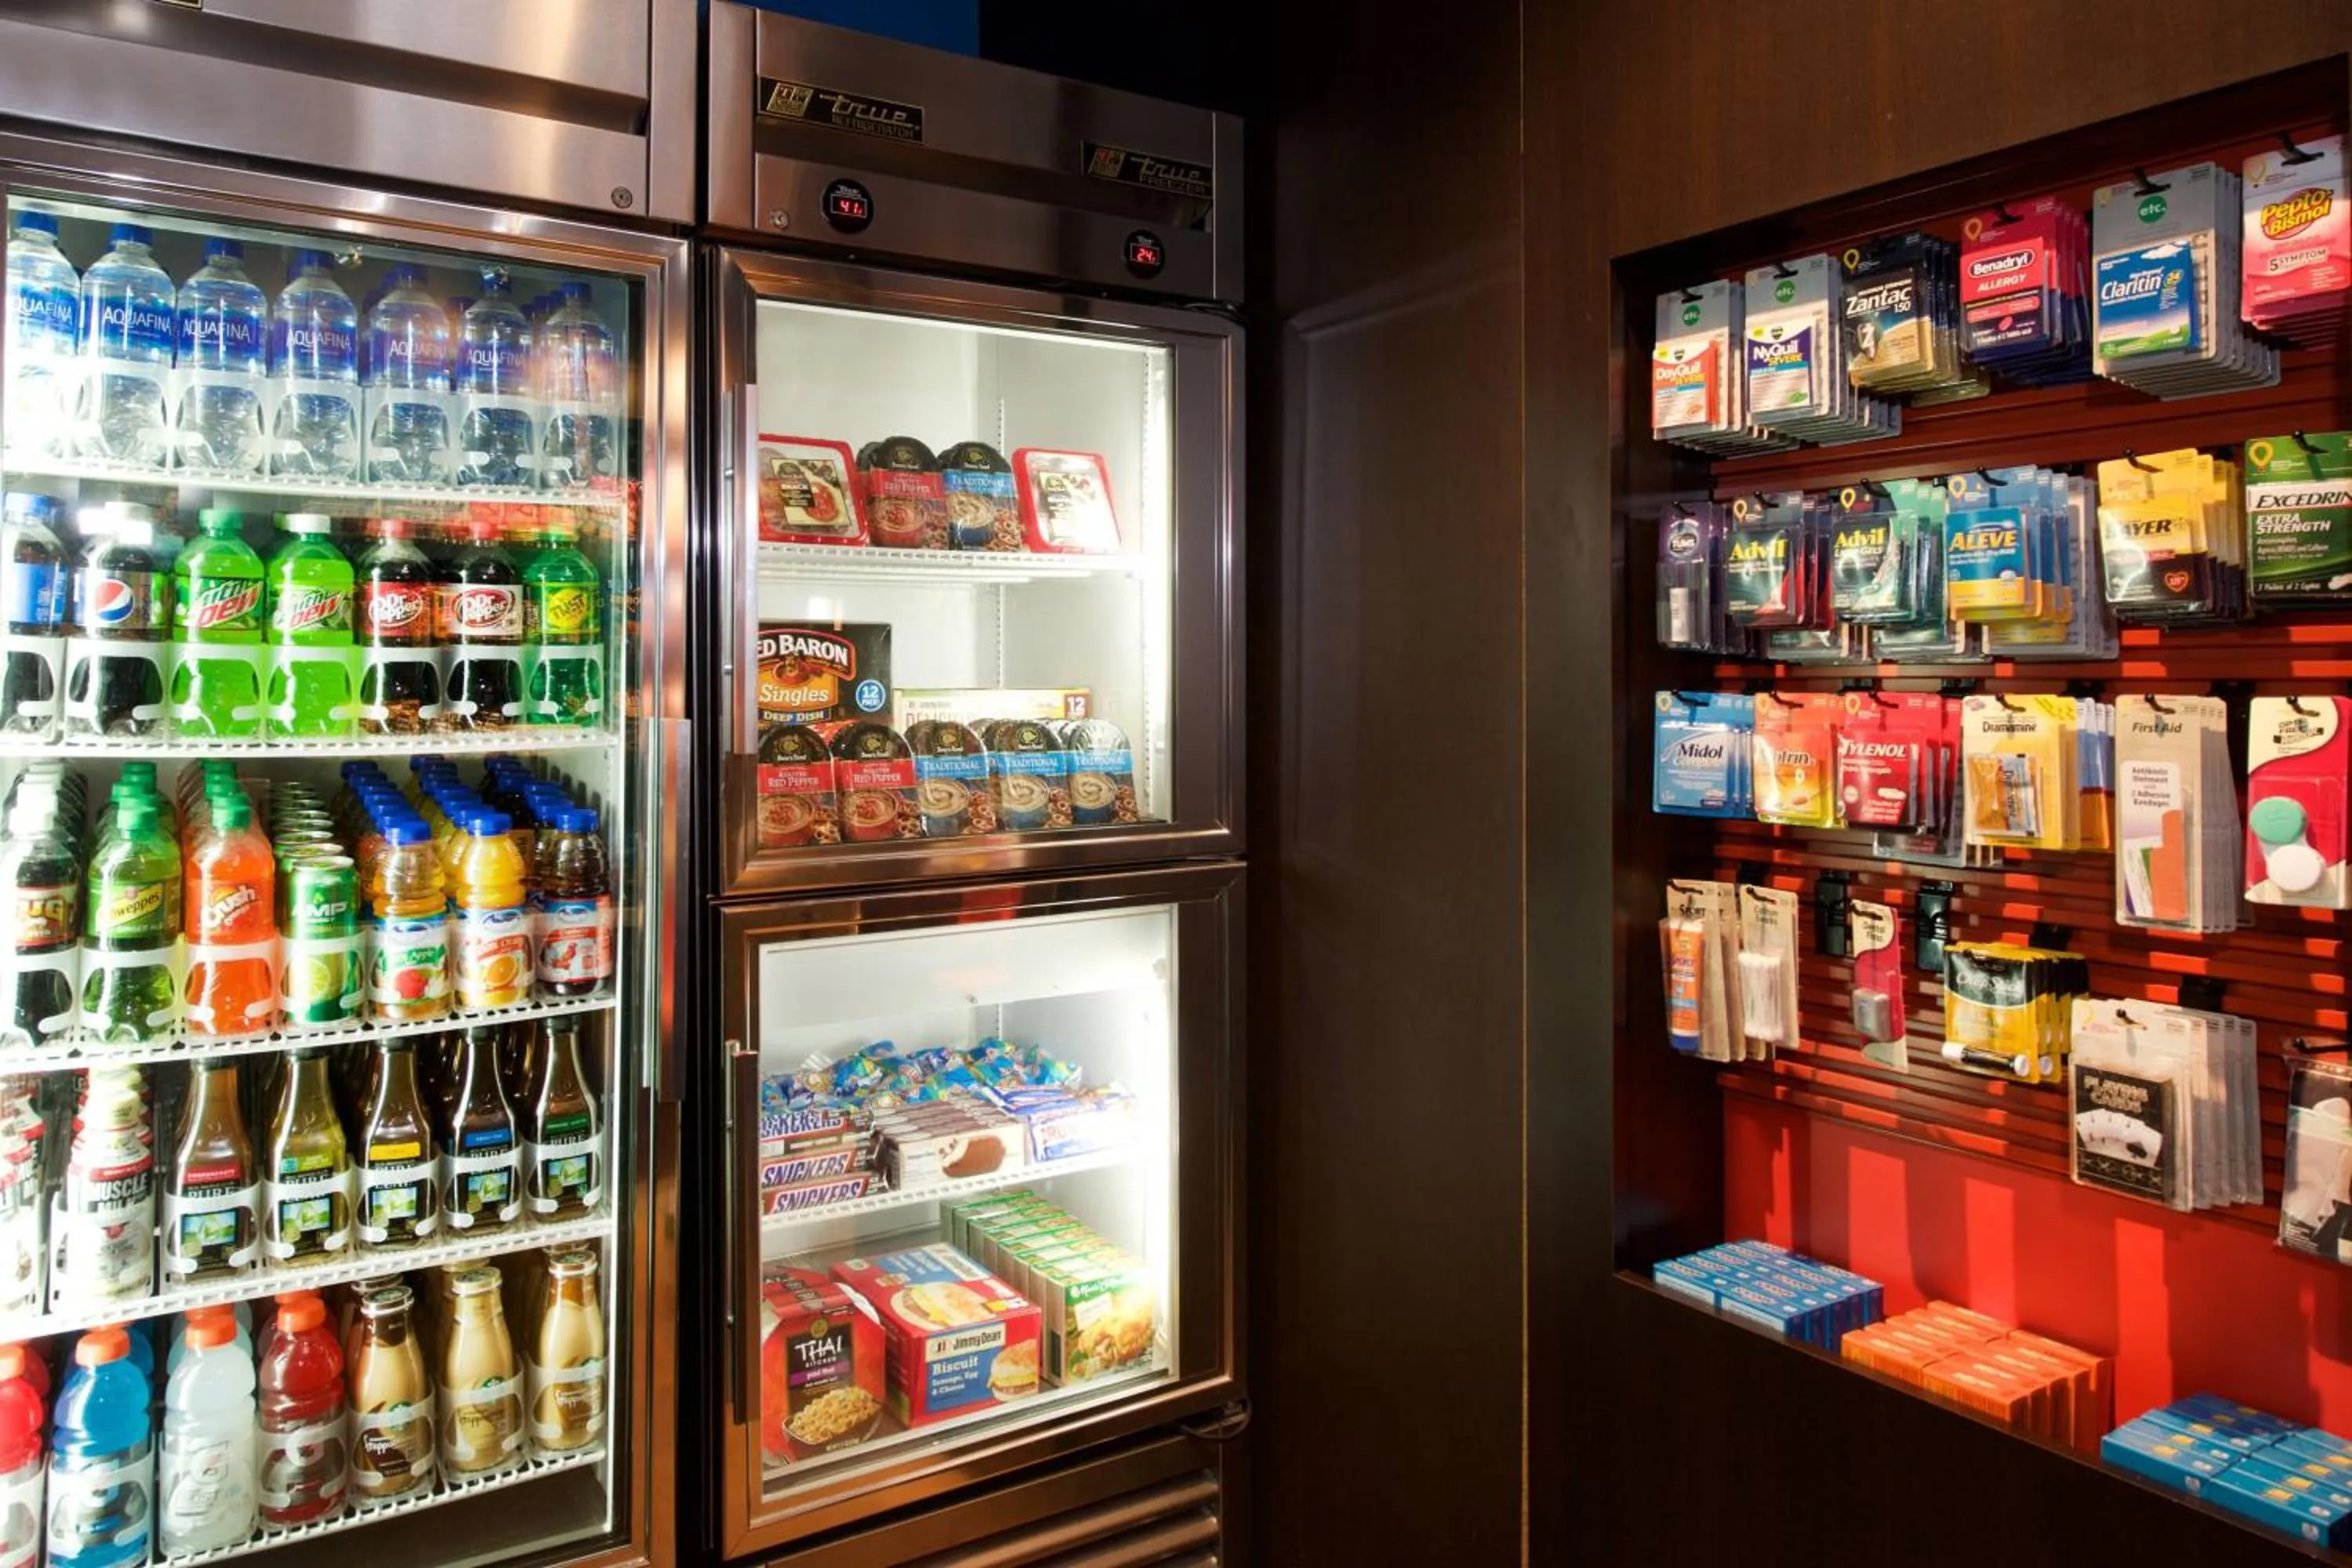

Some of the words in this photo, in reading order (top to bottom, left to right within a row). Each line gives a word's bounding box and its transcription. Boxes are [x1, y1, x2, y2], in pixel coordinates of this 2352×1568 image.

[1139, 173, 1205, 194] FREEZER
[2270, 198, 2332, 236] Bismol
[1973, 252, 2029, 274] Benadryl
[1976, 274, 2027, 293] ALLERGY
[2101, 273, 2161, 300] Claritin
[1846, 287, 1913, 315] Zantac
[1893, 301, 1911, 313] 150
[103, 305, 172, 337] AQUAFINA
[182, 318, 251, 343] AQUAFINA
[286, 329, 352, 352] AQUAFINA
[1753, 340, 1799, 362] NyQuil
[1656, 361, 1700, 381] DayQuil
[2256, 513, 2300, 526] EXTRA
[2256, 521, 2331, 535] STRENGTH
[1835, 527, 1886, 548] Advil
[1949, 530, 2019, 553] ALEVE
[1730, 539, 1788, 560] Advil
[779, 633, 848, 666] BARON
[759, 683, 829, 706] Singles
[862, 685, 879, 698] 12
[1067, 696, 1086, 713] 12
[764, 710, 792, 723] DEEP
[796, 710, 824, 722] DISH
[1982, 720, 2037, 734] Dramamine
[2132, 721, 2158, 734] First
[2160, 721, 2183, 735] Aid
[1677, 742, 1724, 759] Midol
[1838, 739, 1908, 758] TYLENOL
[923, 759, 981, 771] TRADITIONAL
[1007, 757, 1058, 769] TRADITIONAL
[201, 884, 256, 928] Crush
[292, 902, 348, 917] AMP
[762, 1154, 849, 1187] SNICKERS
[776, 1181, 862, 1214] SNICKERS
[794, 1335, 843, 1362] THAI
[805, 1356, 837, 1368] KITCHEN
[931, 1356, 979, 1376] Biscuit
